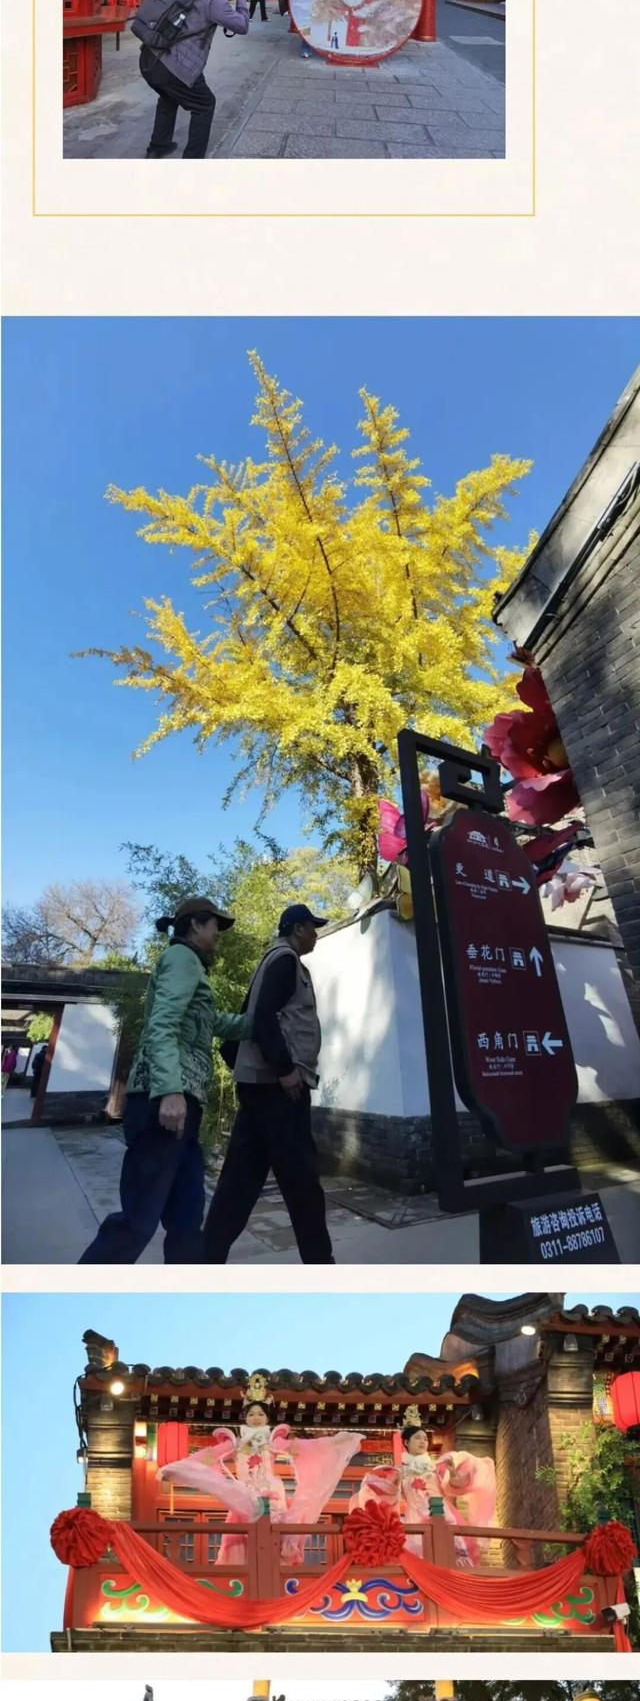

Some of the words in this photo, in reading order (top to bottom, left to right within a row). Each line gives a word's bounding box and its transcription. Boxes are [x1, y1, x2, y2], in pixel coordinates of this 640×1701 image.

[466, 943, 505, 962] 垂花门
[477, 1031, 519, 1050] 西角门
[530, 1202, 602, 1237] 旅游咨询投诉电话
[540, 1227, 605, 1260] 0311-88786107
